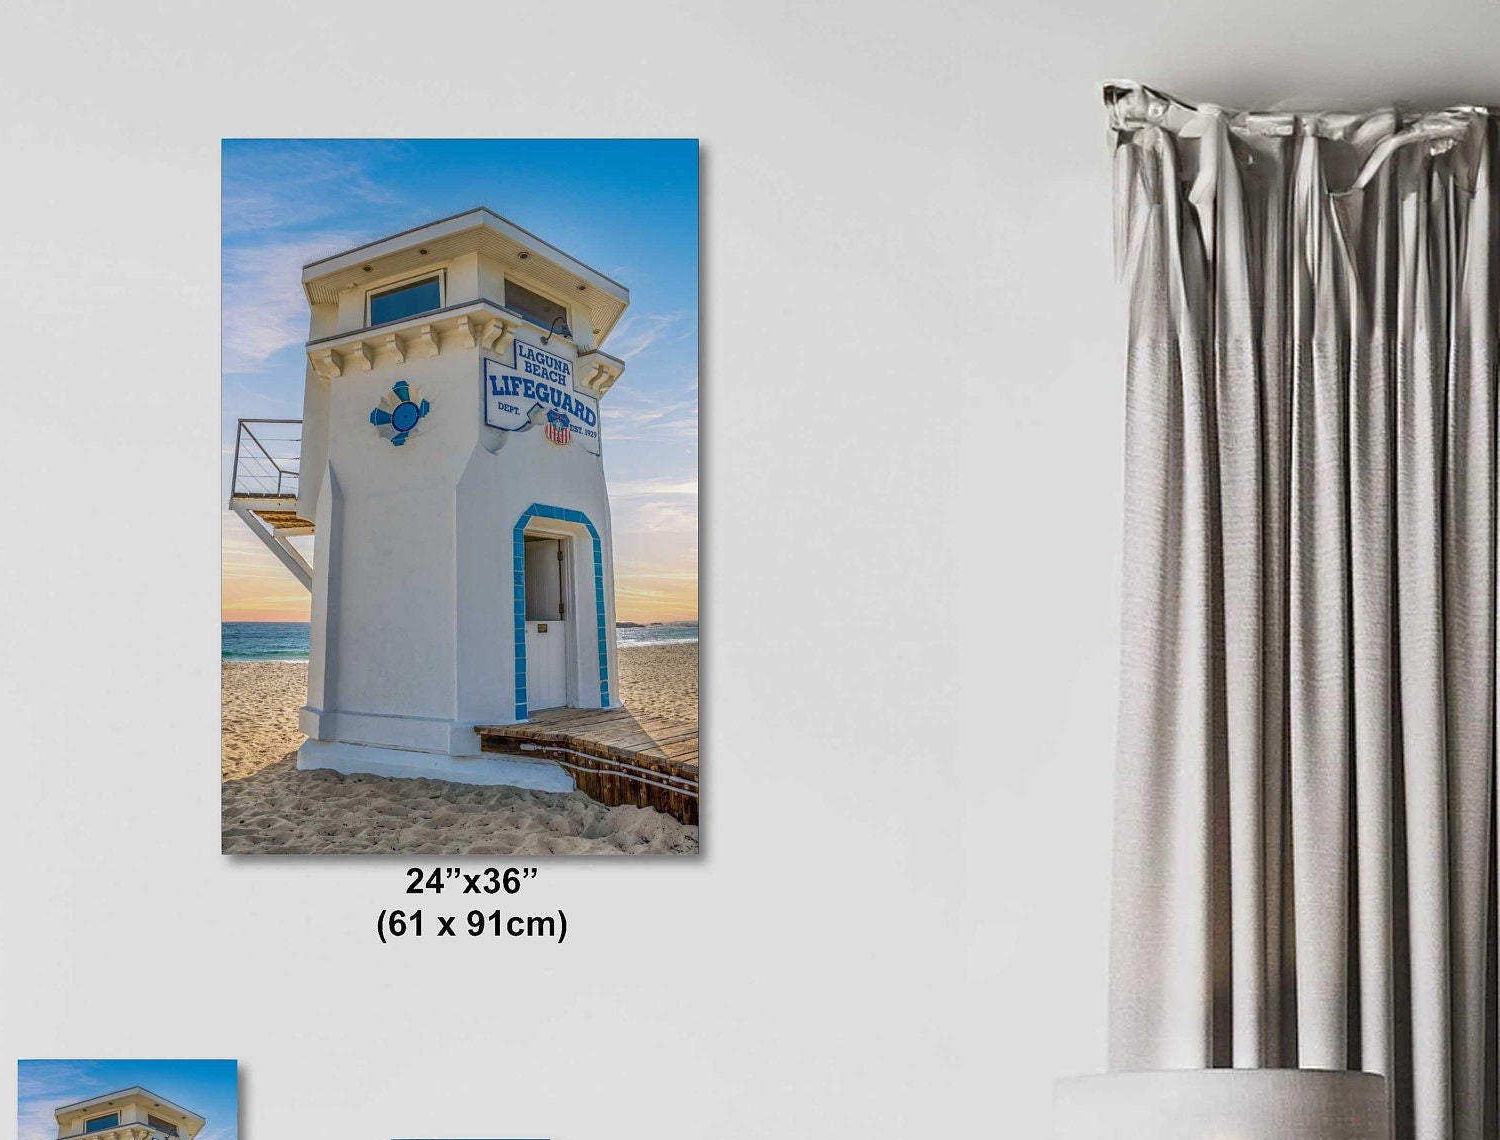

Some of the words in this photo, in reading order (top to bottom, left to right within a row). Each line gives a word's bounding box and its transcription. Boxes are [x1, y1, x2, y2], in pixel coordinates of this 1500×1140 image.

[519, 345, 570, 375] LAGUNA
[525, 361, 566, 386] BEACH
[489, 375, 597, 427] LIFEGUARD
[498, 402, 520, 415] DEPT.
[570, 425, 583, 435] EST.
